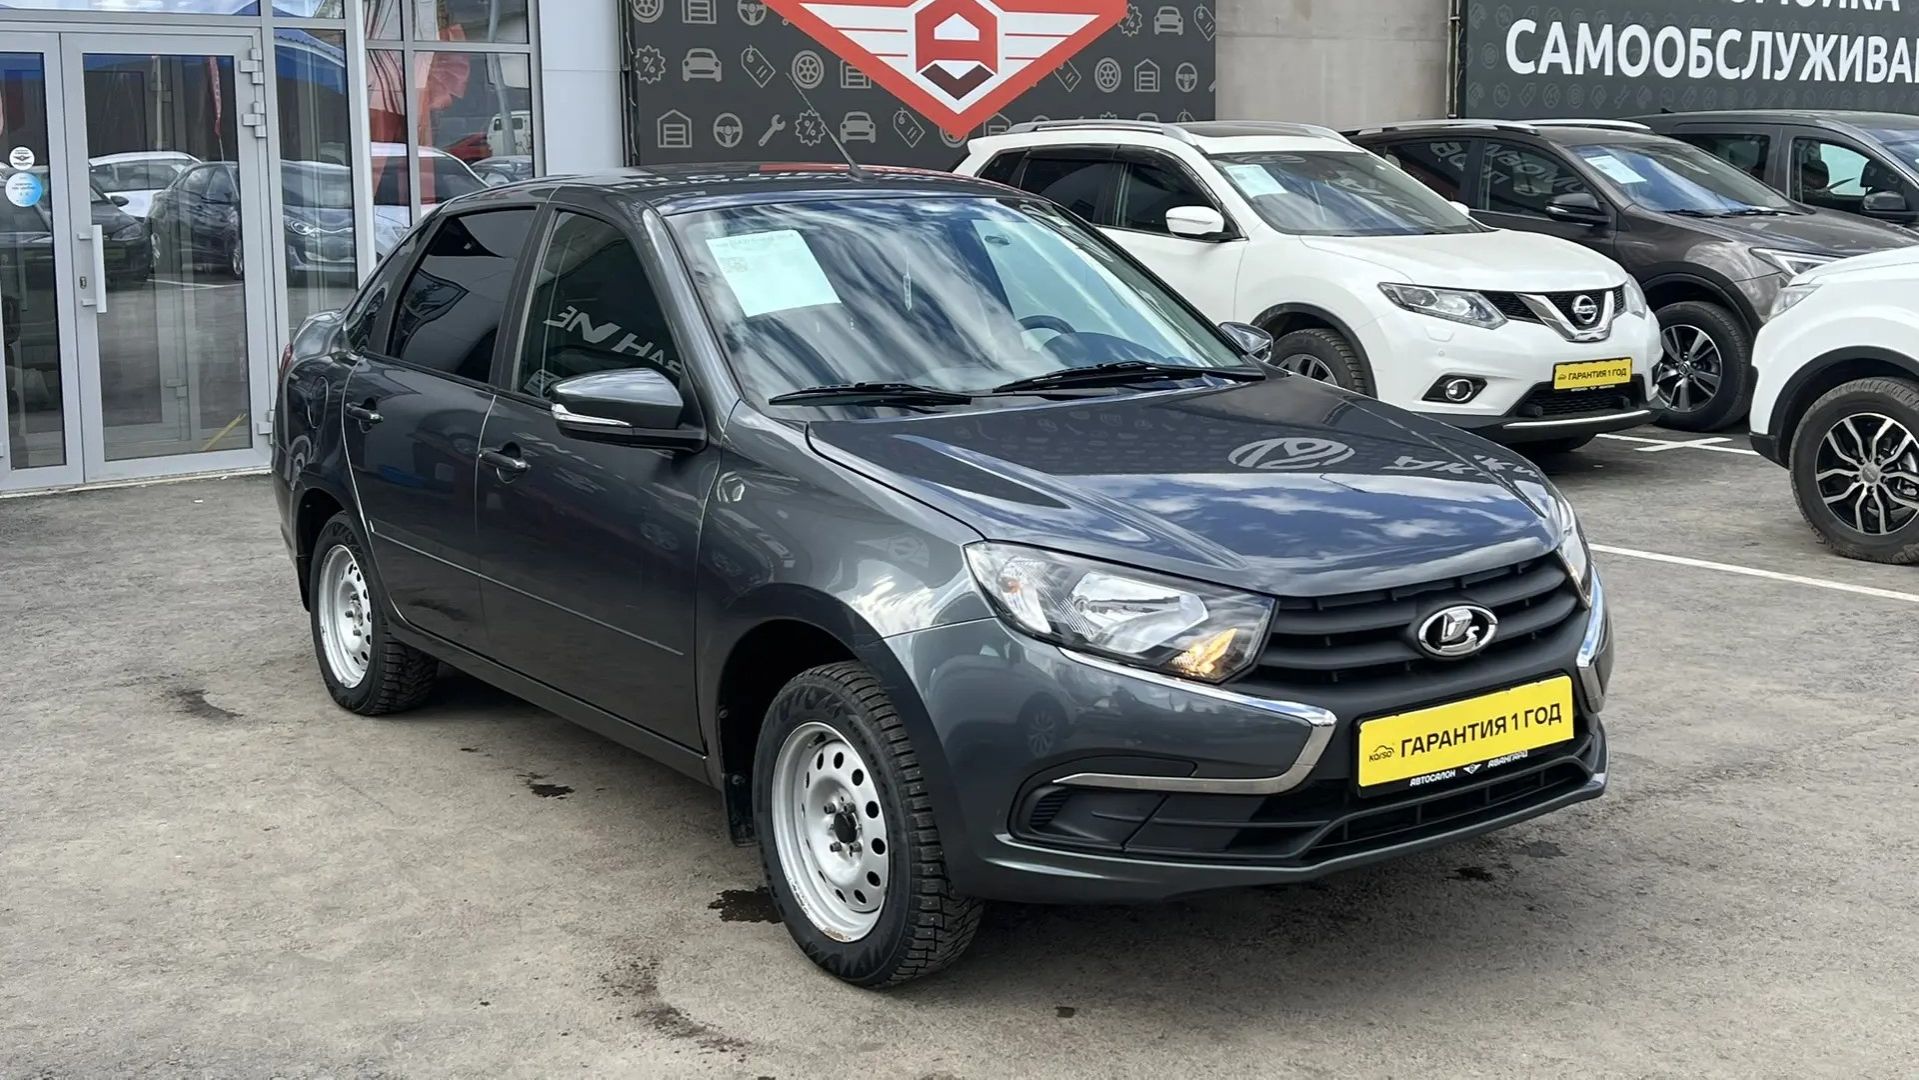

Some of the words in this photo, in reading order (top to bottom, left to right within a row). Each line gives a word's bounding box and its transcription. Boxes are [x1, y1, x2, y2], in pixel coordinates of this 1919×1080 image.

[1505, 19, 1919, 83] САМООБСЛУЖИВА
[1568, 370, 1607, 380] ГАРАНТИЯ
[1612, 368, 1627, 377] ГОД
[1400, 715, 1507, 758] ГАРАНТИЯ
[1511, 713, 1519, 731] 1
[1524, 702, 1562, 728] ГОД
[1409, 770, 1456, 787] АВТОСАЛОН
[1487, 750, 1528, 769] АВАНГАРД
